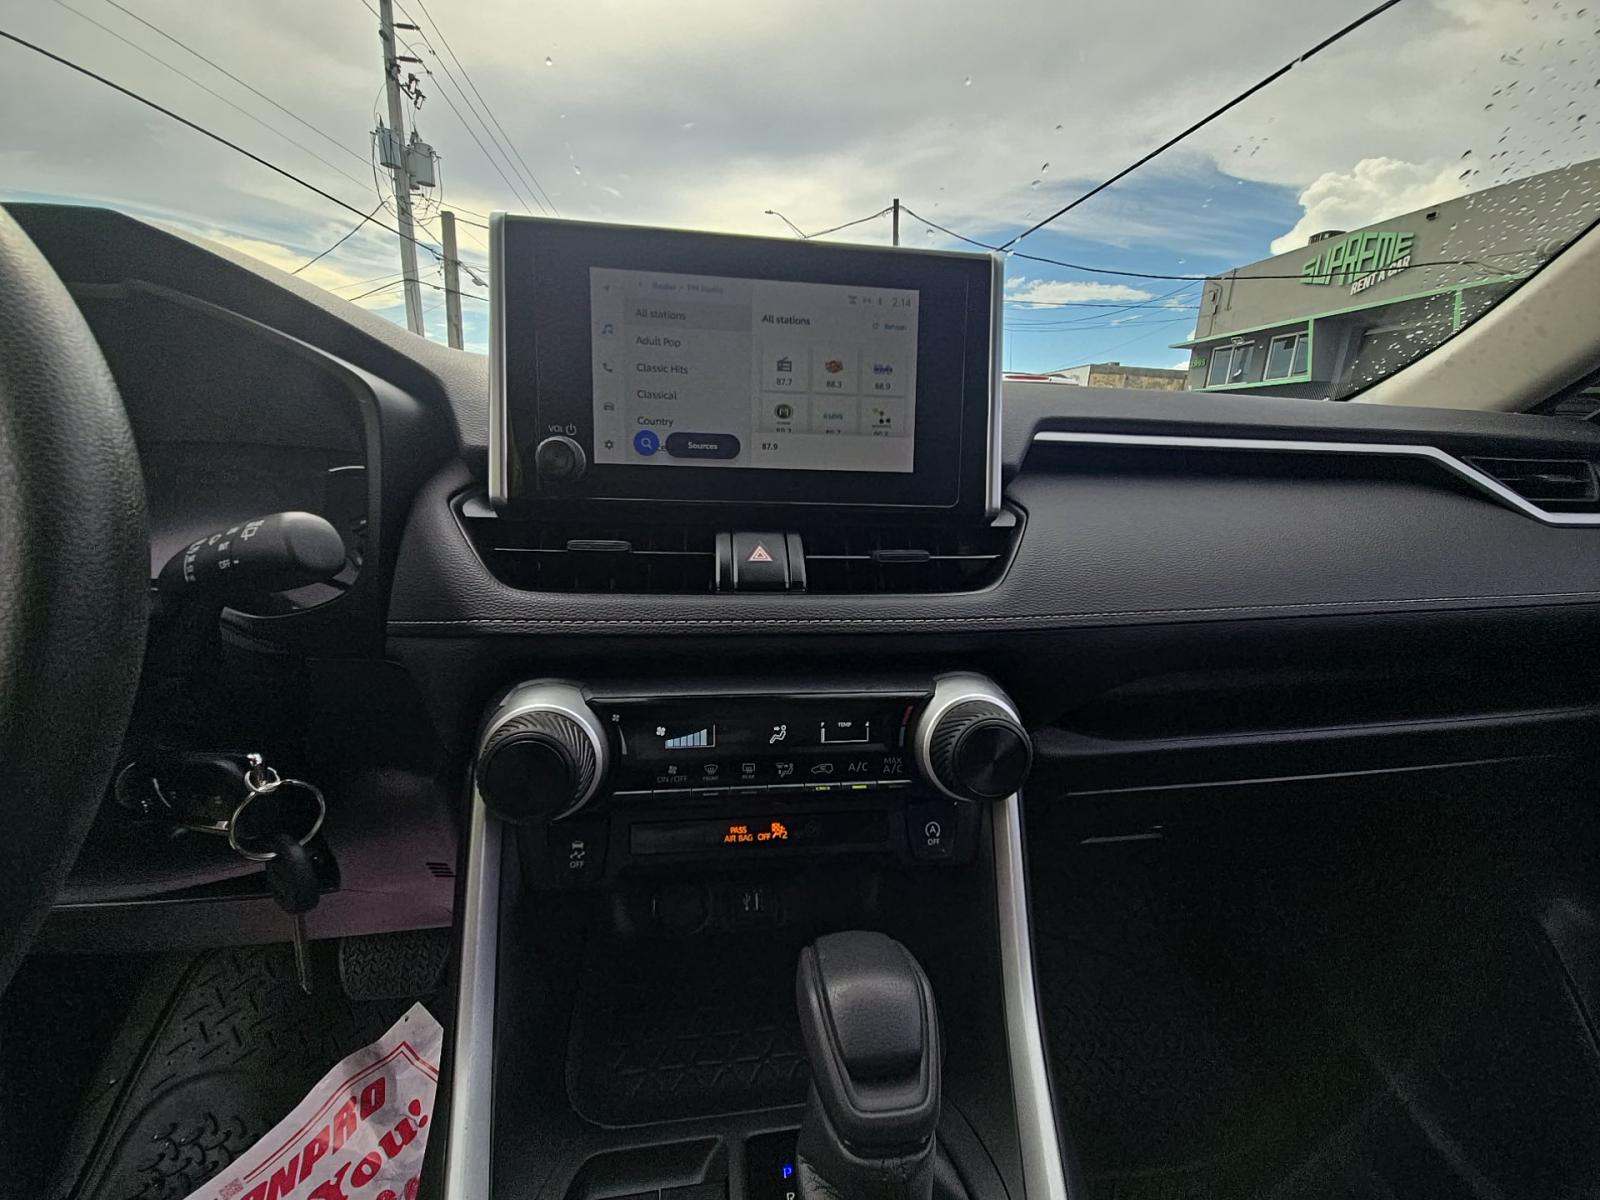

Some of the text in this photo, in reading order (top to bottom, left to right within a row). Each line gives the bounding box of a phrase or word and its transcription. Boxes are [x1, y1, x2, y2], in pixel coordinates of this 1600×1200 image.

[1300, 231, 1414, 286] SUPREME
[1350, 255, 1410, 296] RENT A CAR
[636, 308, 686, 320] All stations
[761, 314, 810, 326] All stations
[636, 336, 681, 348] Adult Pop
[636, 363, 688, 375] Classic Hits
[637, 390, 677, 401] Classical
[637, 416, 674, 427] Country
[688, 441, 719, 451] Sources
[762, 443, 778, 451] 87.9
[883, 756, 902, 765] MAX
[848, 761, 868, 773] A/C
[882, 765, 904, 774] A/C
[729, 825, 748, 834] PASS
[724, 832, 771, 843] AIR BAG OFF
[927, 838, 940, 846] OFF
[783, 1166, 792, 1179] P
